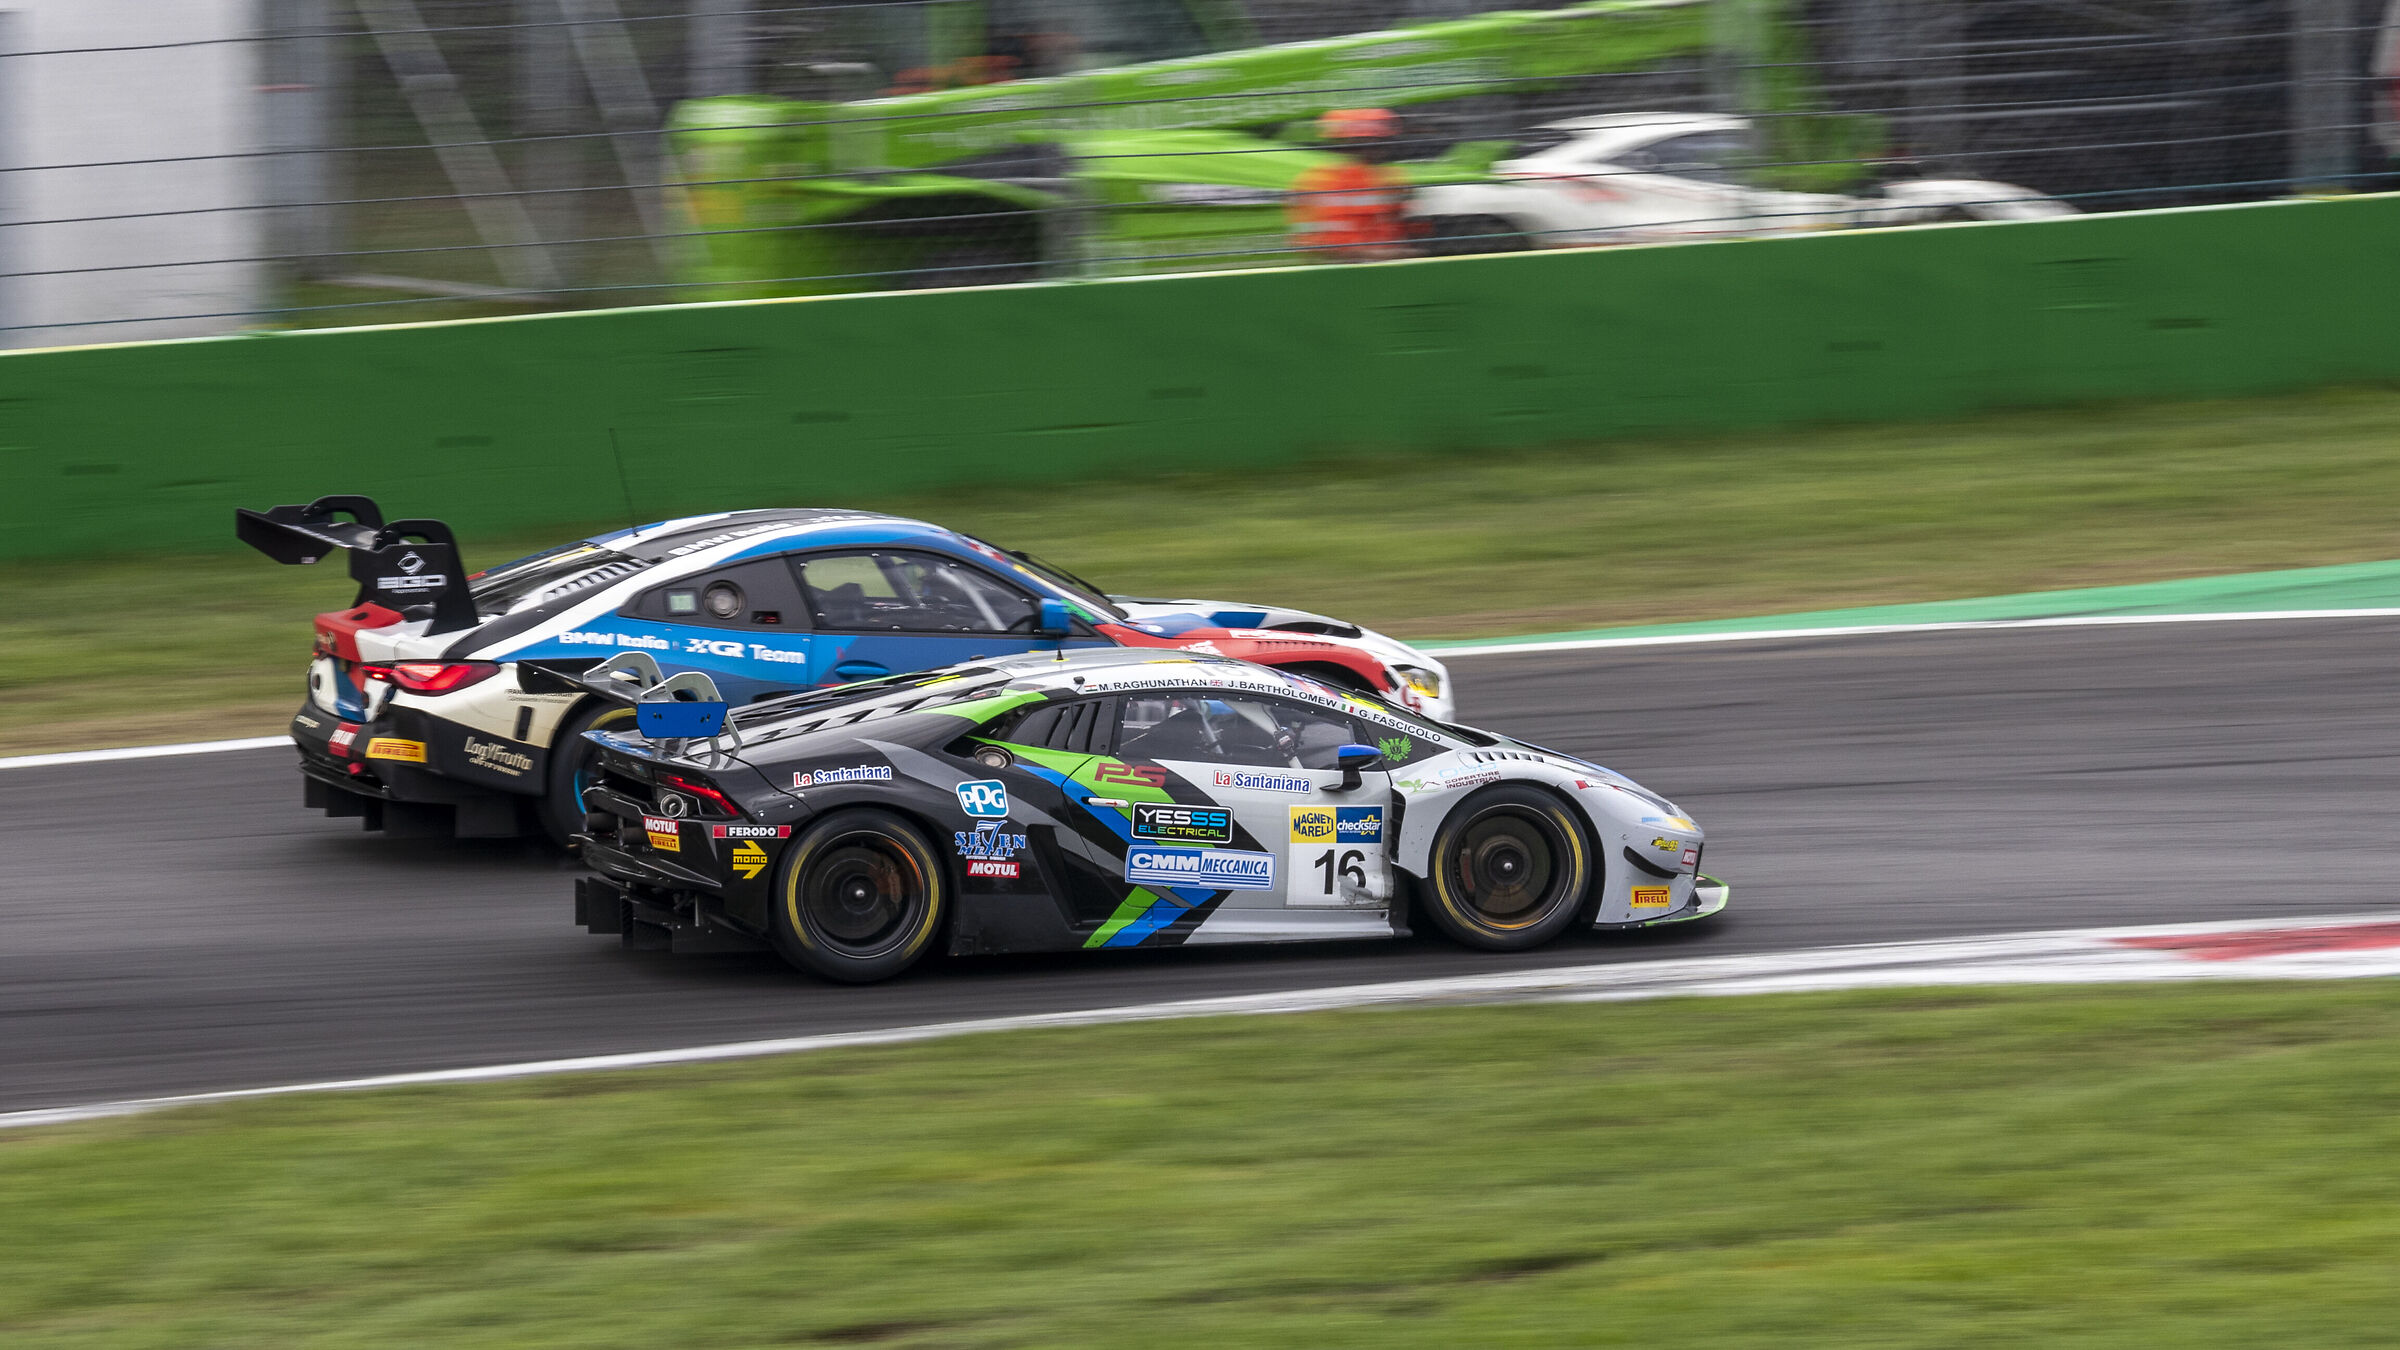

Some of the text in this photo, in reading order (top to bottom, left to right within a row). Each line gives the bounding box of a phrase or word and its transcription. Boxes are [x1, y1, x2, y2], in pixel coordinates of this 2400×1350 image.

[559, 632, 614, 645] BMW
[618, 633, 669, 650] Italia
[749, 644, 806, 664] Team
[794, 765, 891, 787] La Santaniana
[1094, 762, 1167, 788] PS
[1215, 771, 1310, 793] La Santaniana
[1444, 771, 1500, 784] COPERTURE
[960, 785, 1005, 813] PPG
[645, 818, 677, 833] MOTUL
[1139, 808, 1227, 827] YESSS
[1336, 819, 1381, 831] checkstar
[728, 826, 777, 837] FERODO
[954, 820, 1027, 850] SEVEN
[1138, 825, 1226, 838] ELECTRICAL
[651, 835, 677, 849] PIRELLI
[733, 855, 767, 864] momo
[1132, 853, 1200, 872] CMM
[1201, 858, 1268, 875] MECCANICA
[970, 862, 1018, 876] MOTUL
[1314, 848, 1367, 895] 16
[1634, 889, 1668, 904] PIRELLI
